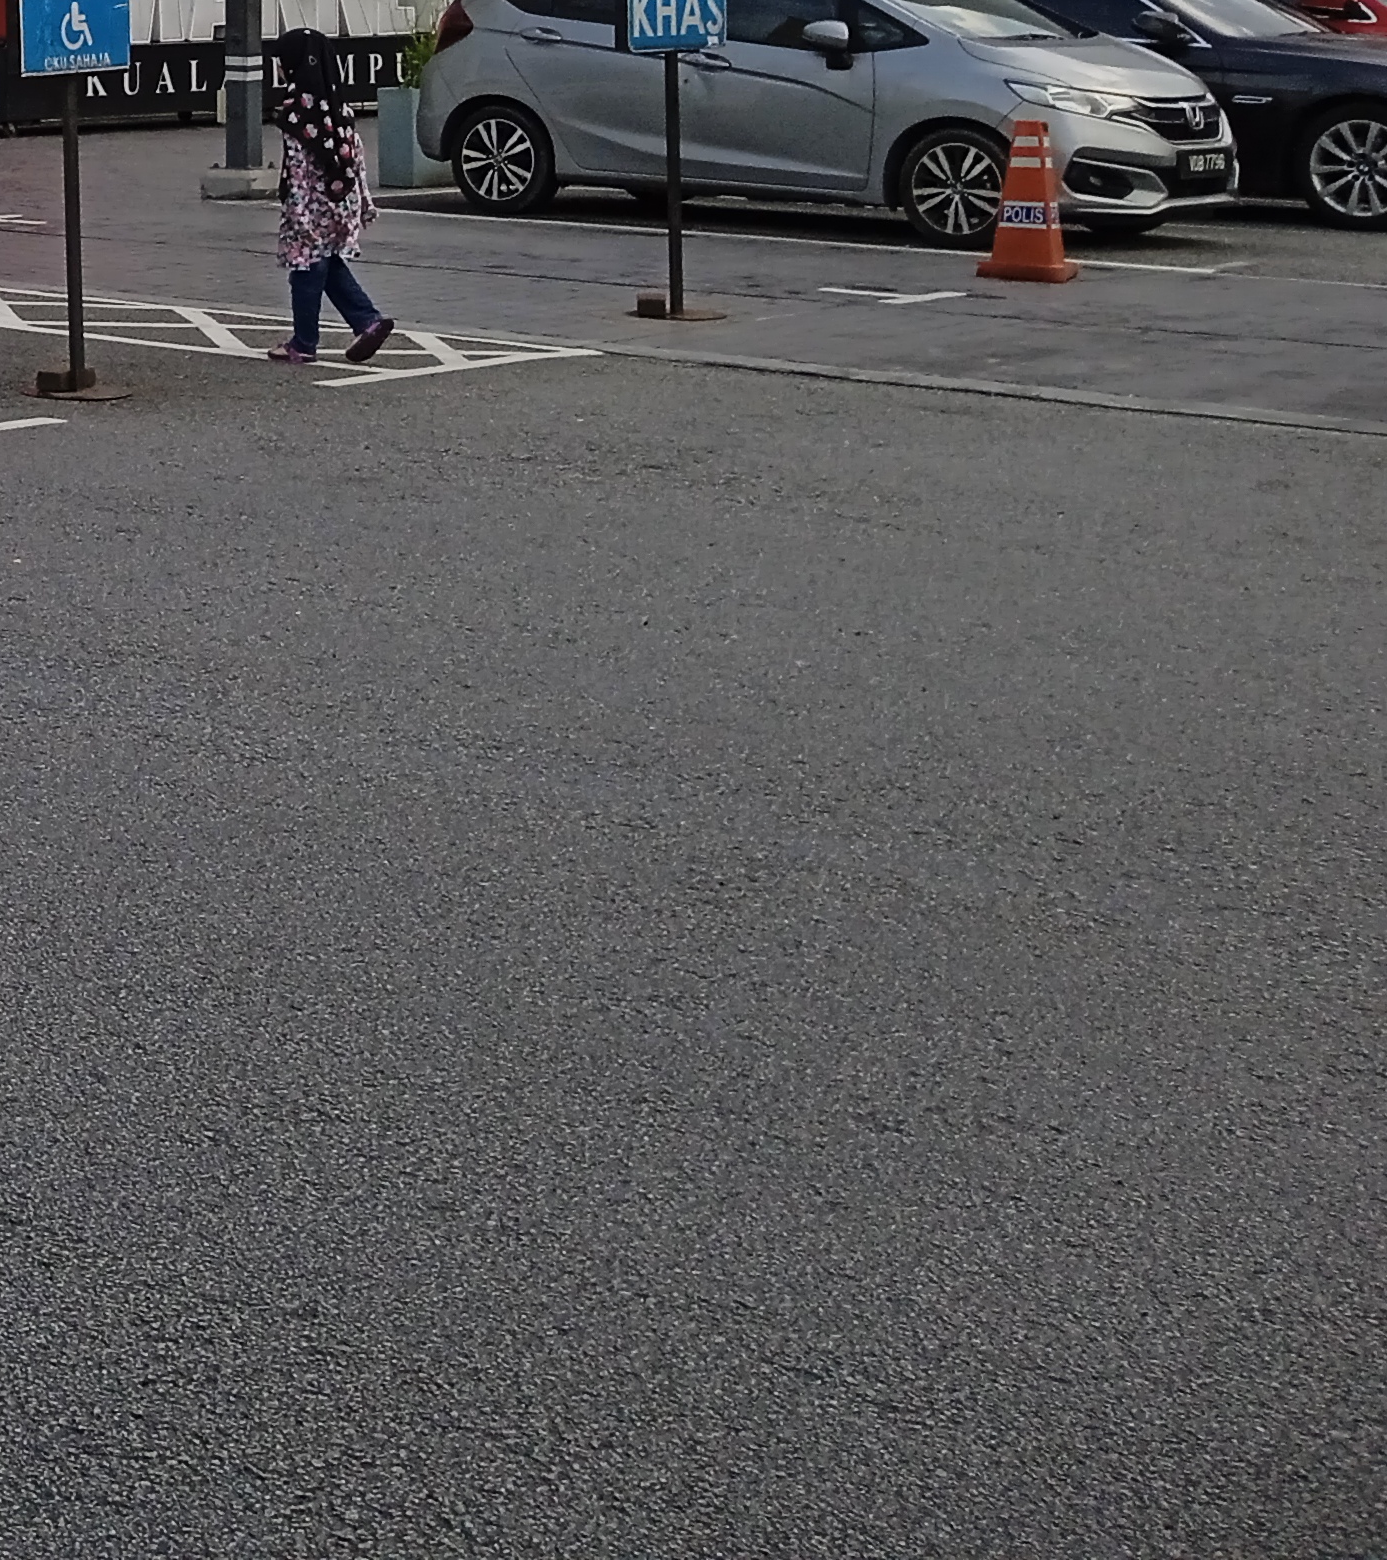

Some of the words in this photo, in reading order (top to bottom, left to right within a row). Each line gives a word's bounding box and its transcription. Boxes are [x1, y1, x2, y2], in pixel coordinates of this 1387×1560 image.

[69, 52, 111, 69] SAHAJA
[86, 60, 226, 97] KUAL
[1004, 206, 1044, 223] POLIS
